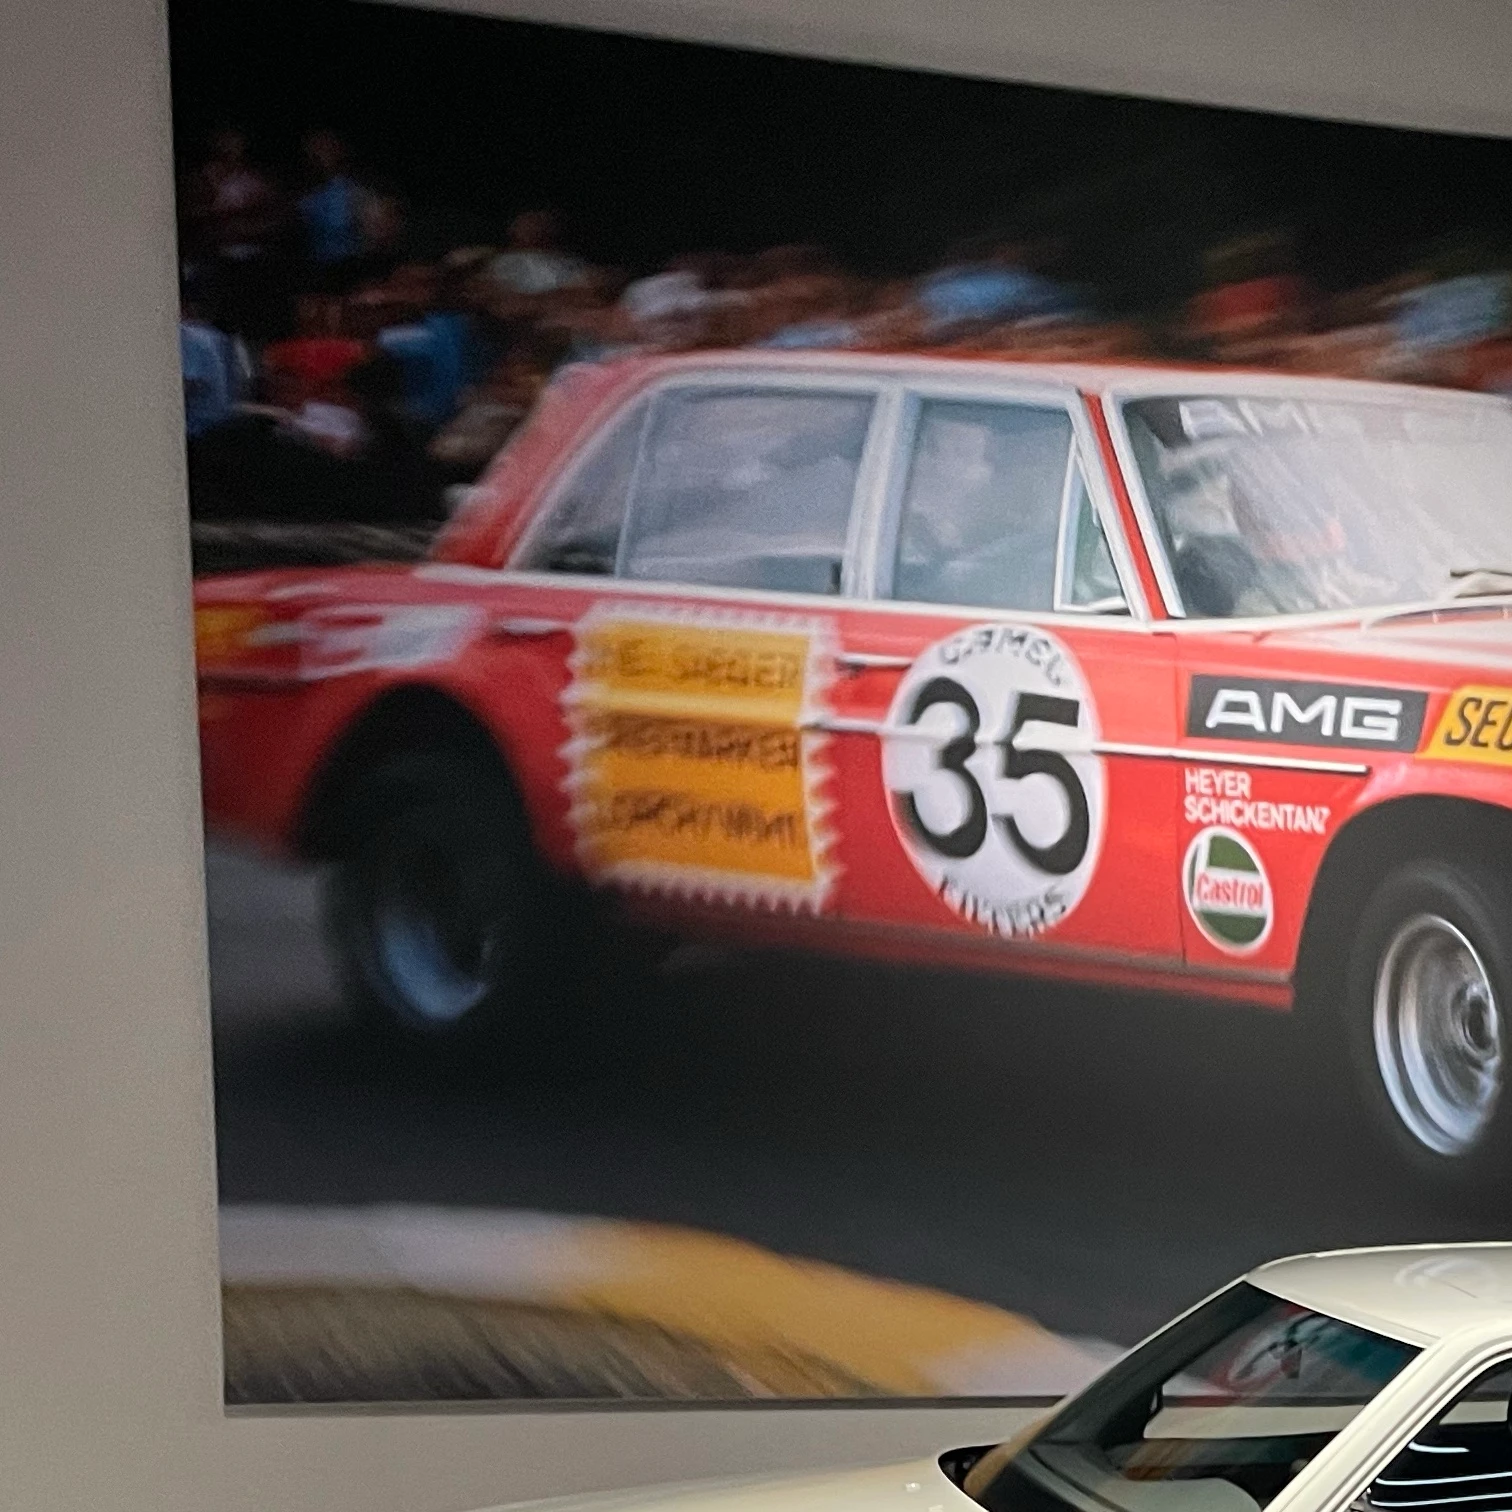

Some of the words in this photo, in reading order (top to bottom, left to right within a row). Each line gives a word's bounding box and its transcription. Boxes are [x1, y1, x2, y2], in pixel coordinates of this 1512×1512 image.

[1206, 689, 1402, 741] AMG
[891, 676, 1089, 876] 35
[1184, 767, 1252, 799] HEYER
[1184, 795, 1331, 835] SCHICKENTANZ
[1196, 871, 1265, 911] Castrol
